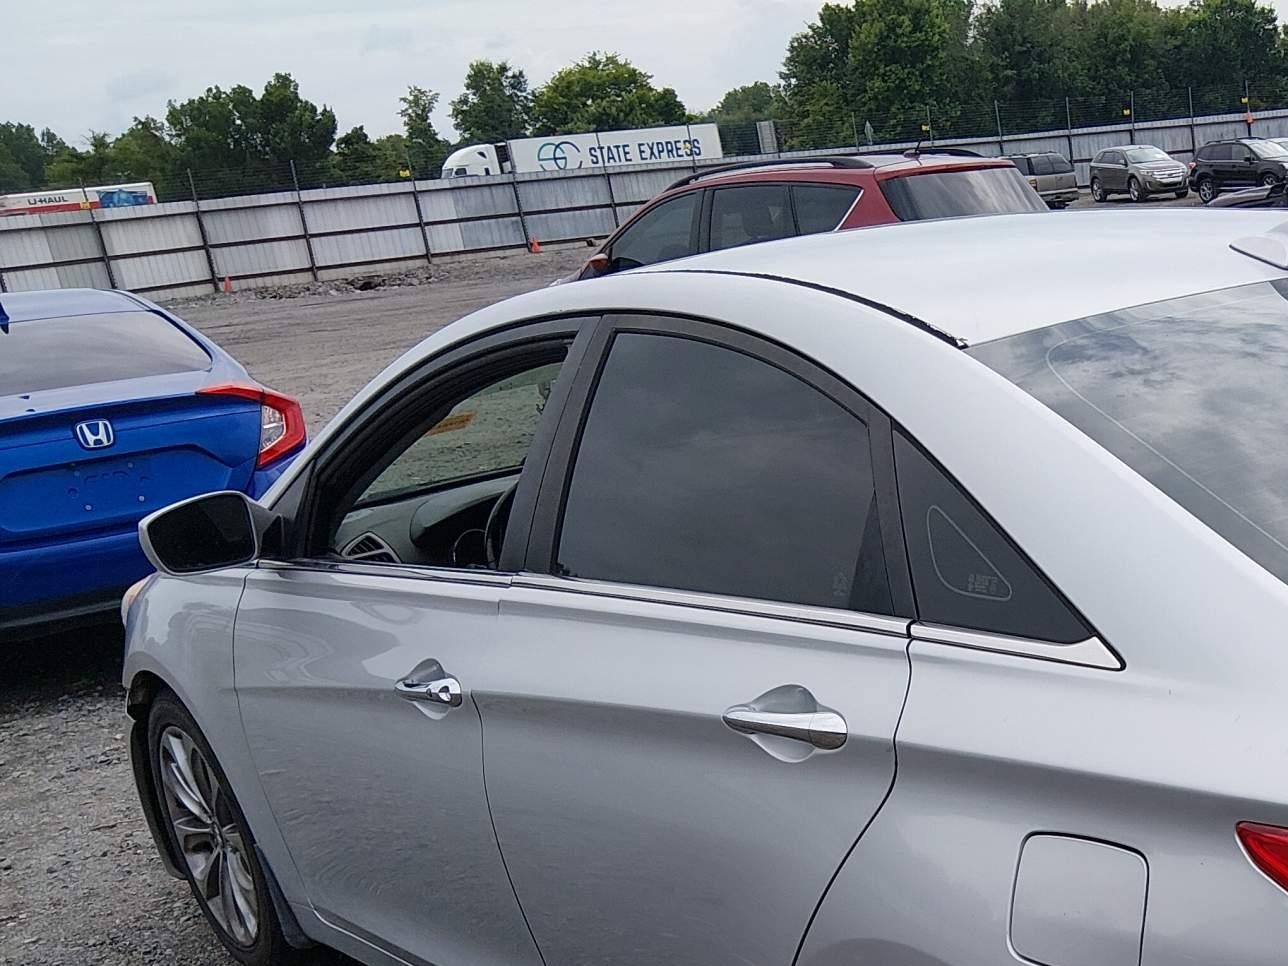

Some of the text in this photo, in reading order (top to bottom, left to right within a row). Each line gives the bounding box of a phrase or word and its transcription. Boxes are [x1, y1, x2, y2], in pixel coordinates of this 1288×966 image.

[589, 139, 701, 164] STATE EXPRESS
[27, 195, 69, 206] U-HAUL
